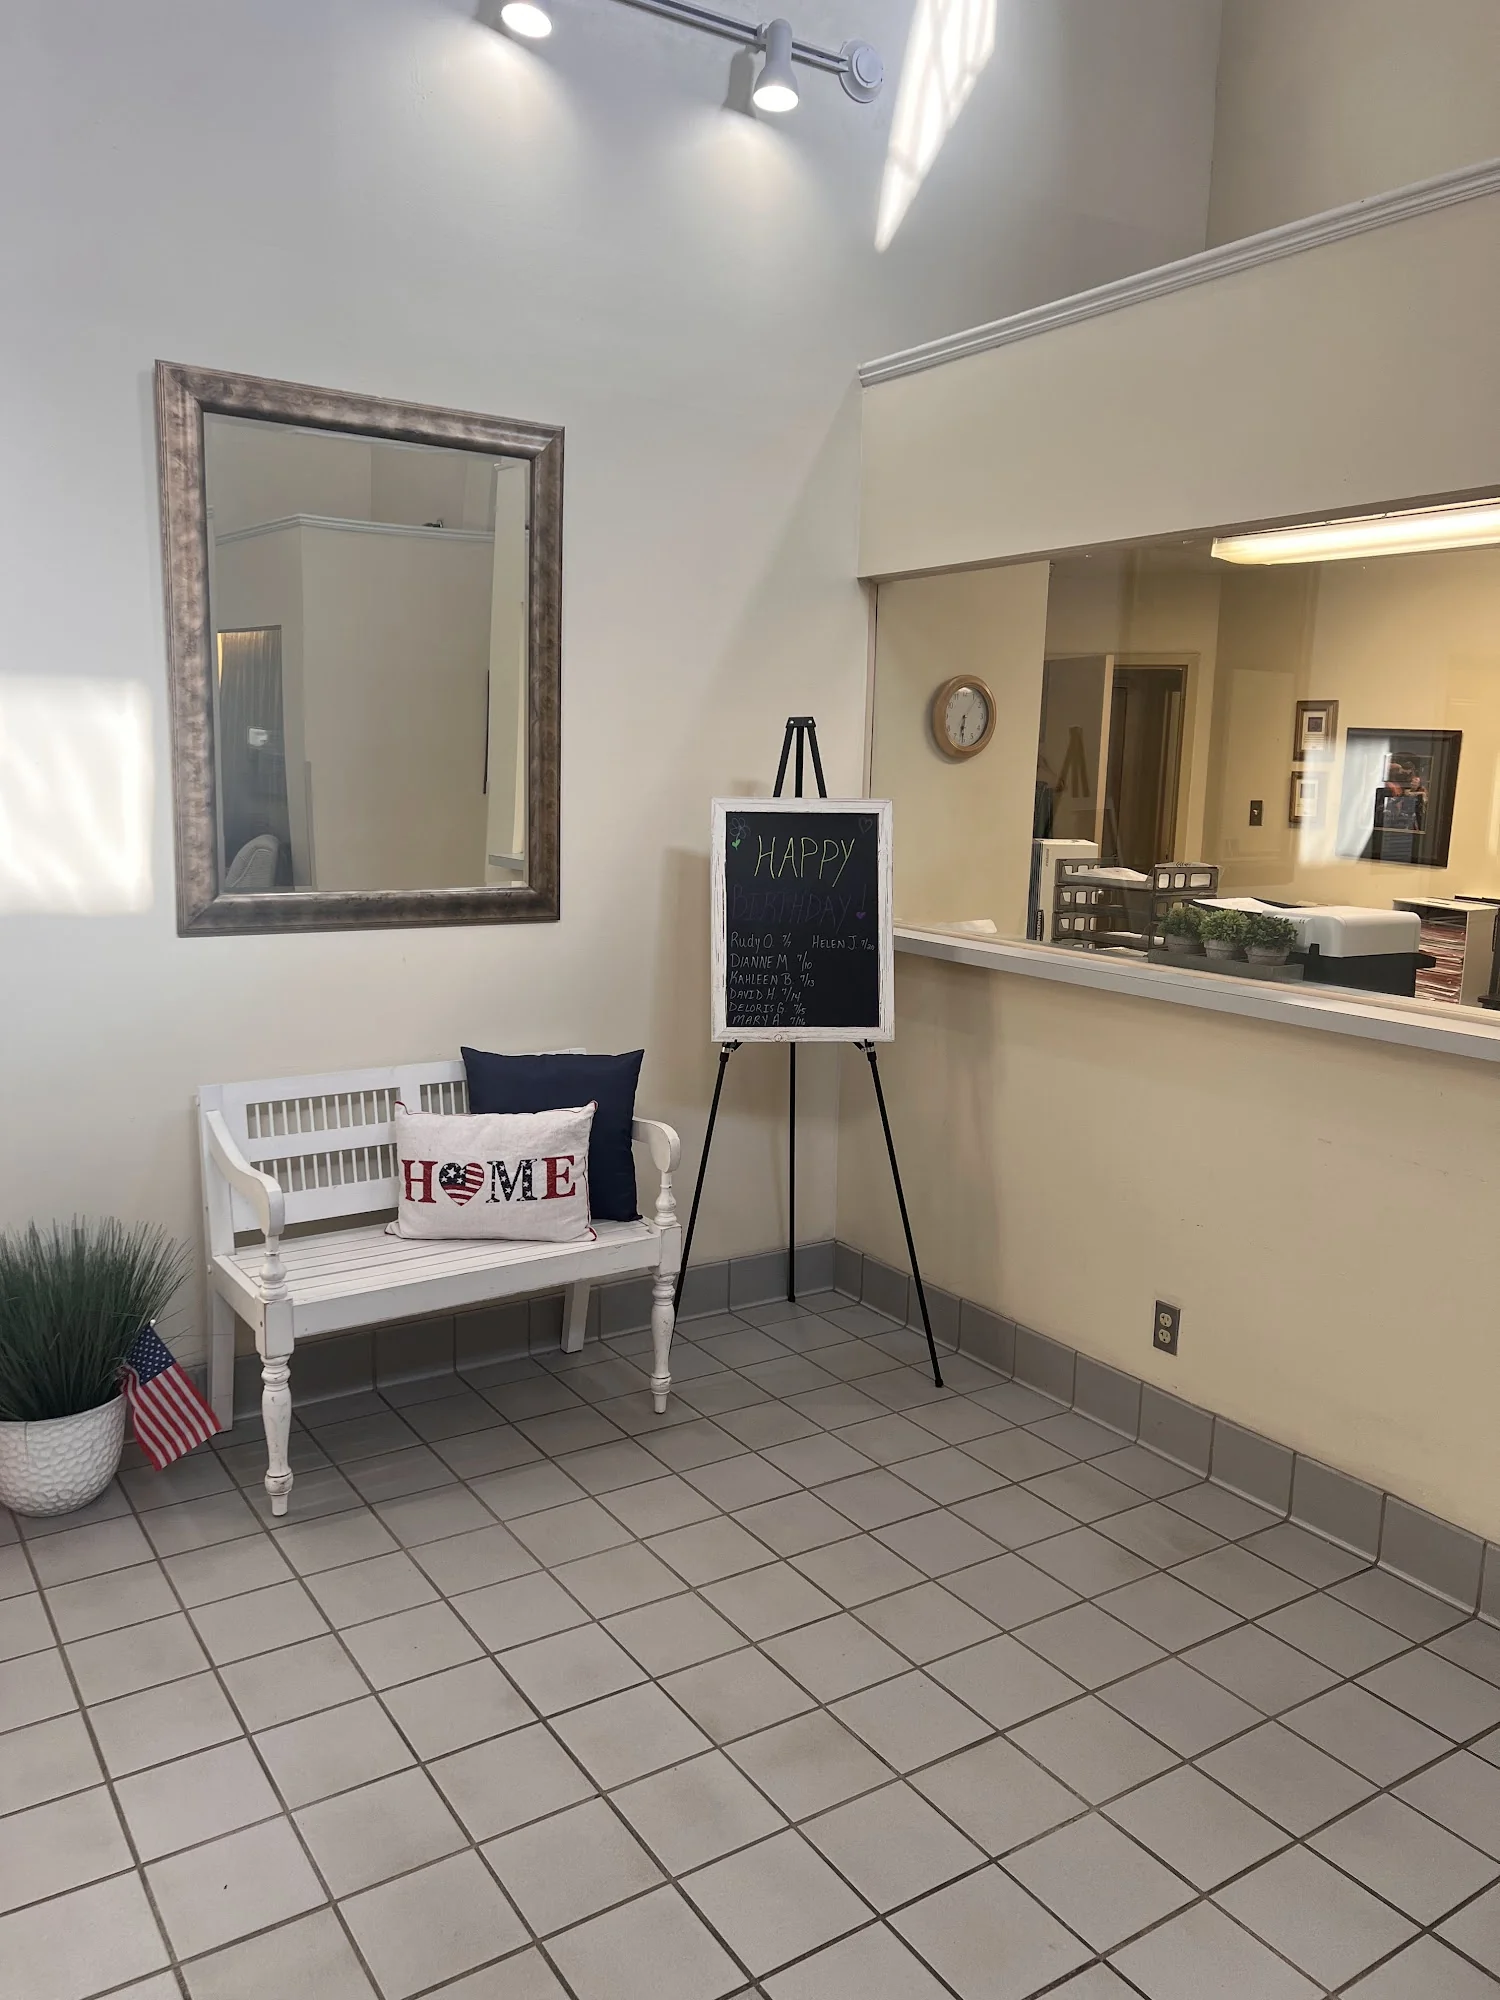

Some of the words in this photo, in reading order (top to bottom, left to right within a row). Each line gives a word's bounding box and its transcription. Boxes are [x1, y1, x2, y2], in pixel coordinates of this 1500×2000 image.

[753, 834, 856, 888] HAPPY
[730, 931, 760, 954] Rudy
[811, 934, 846, 949] HELEN
[730, 952, 775, 969] DIANNE
[797, 950, 813, 972] 7/10
[730, 987, 763, 1000] DAVID
[781, 986, 801, 1002] 7/14
[728, 1001, 775, 1014] DELORIS
[732, 1014, 769, 1026] MARY
